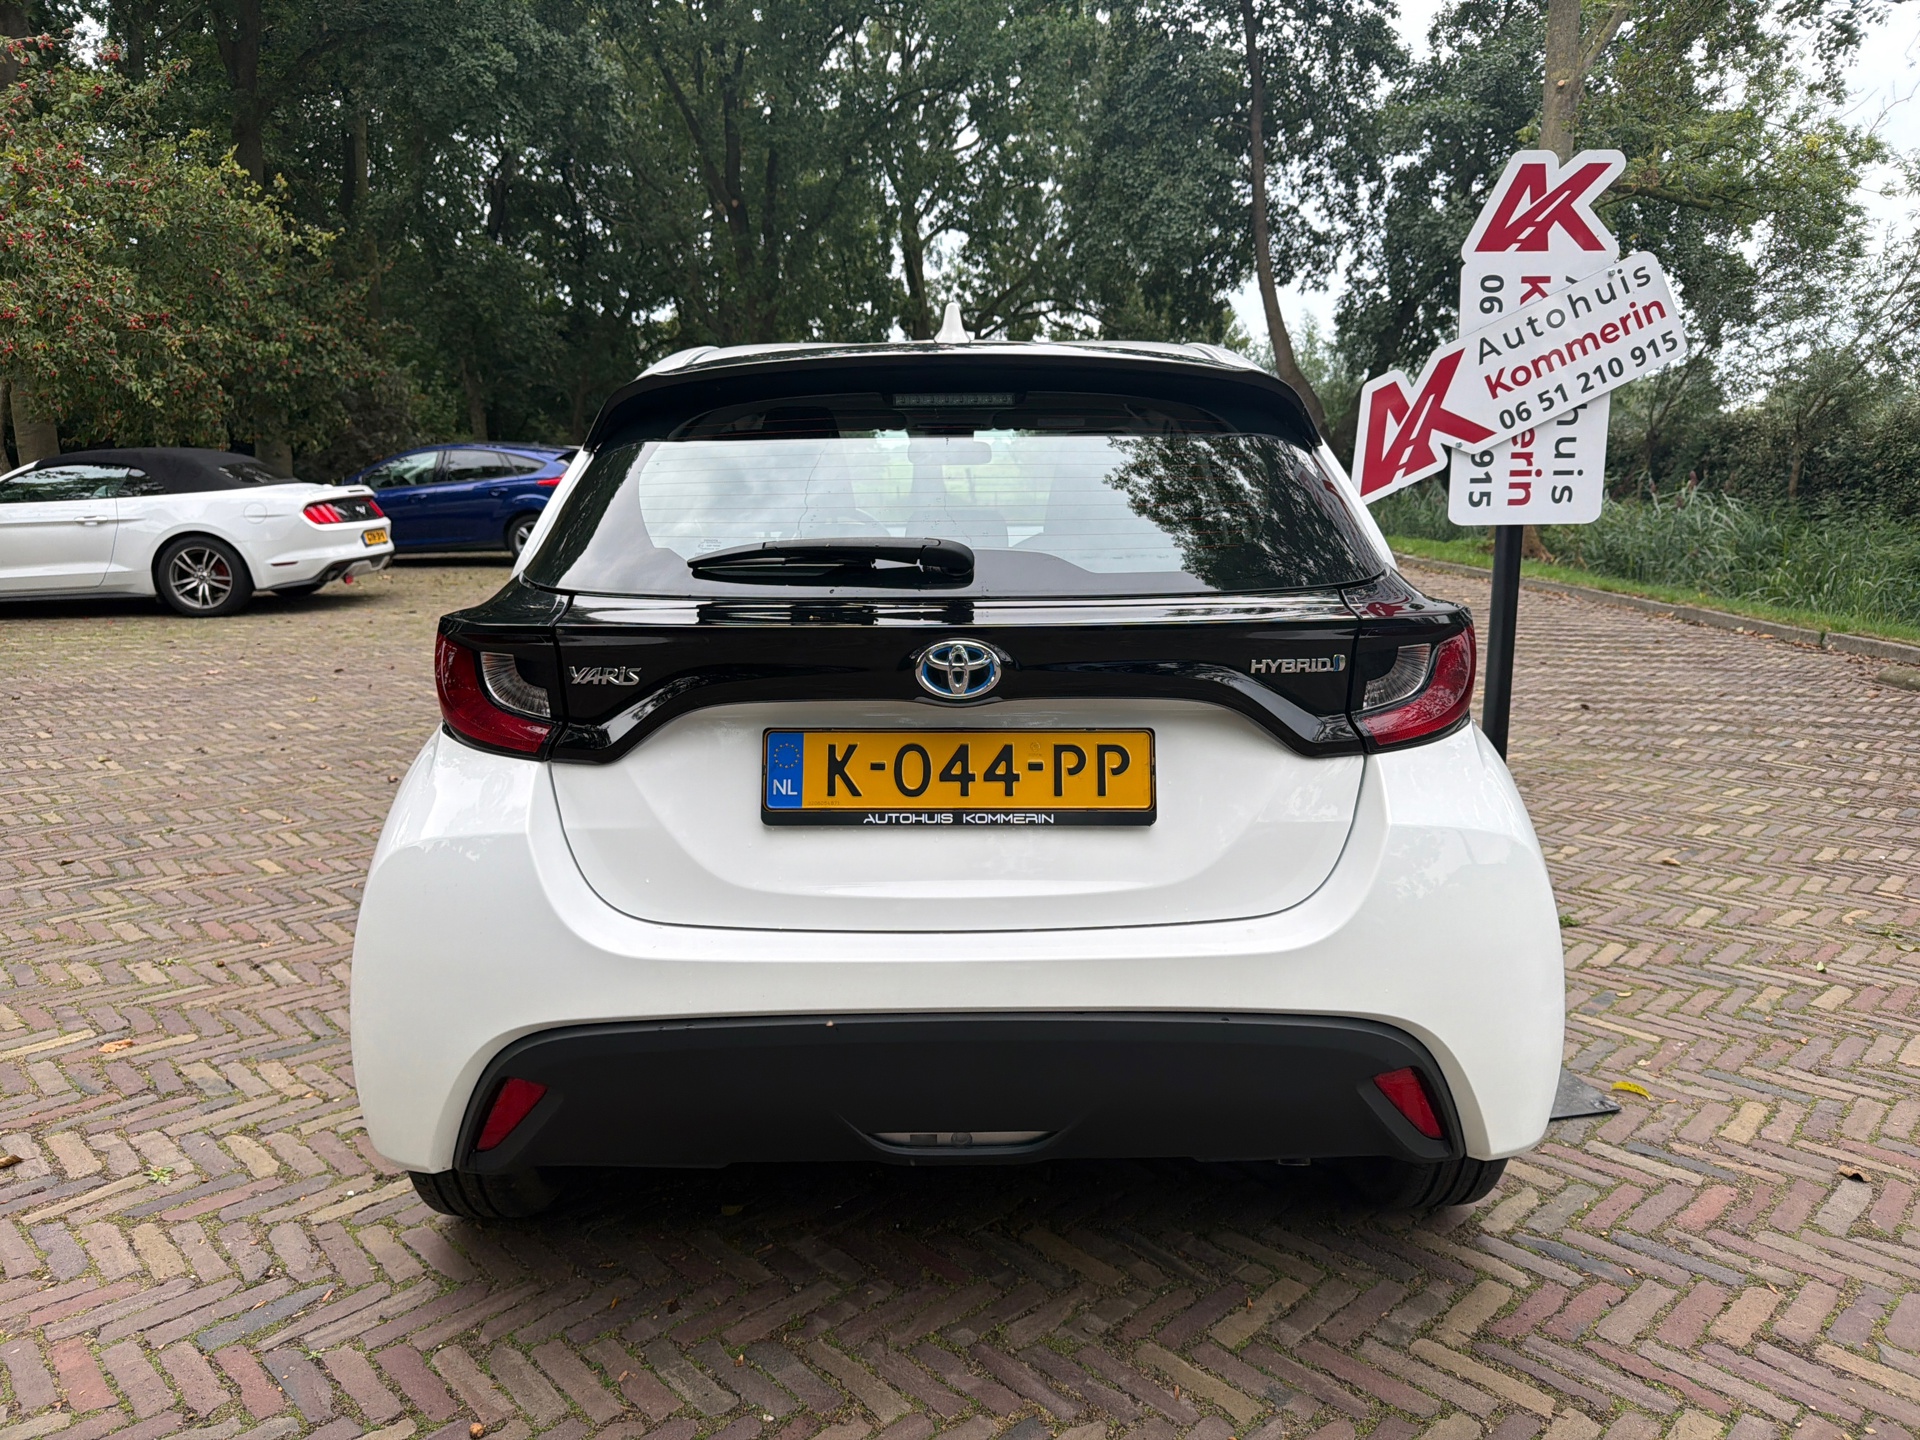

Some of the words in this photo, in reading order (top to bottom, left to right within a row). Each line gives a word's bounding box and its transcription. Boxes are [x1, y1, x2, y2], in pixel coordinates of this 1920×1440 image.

[1477, 265, 1652, 366] Autohuis
[1479, 274, 1505, 315] 06
[1484, 300, 1667, 400] Kommerin
[1498, 401, 1533, 431] 06
[1537, 383, 1570, 413] 51
[1576, 357, 1625, 394] 210
[1630, 330, 1679, 369] 915
[1468, 449, 1495, 508] 915
[1250, 657, 1334, 674] HYBRID
[772, 779, 798, 796] NL
[826, 743, 1132, 798] K-044-PP
[862, 813, 954, 825] AUTOHUIS
[963, 813, 1055, 825] KOMMERIN
